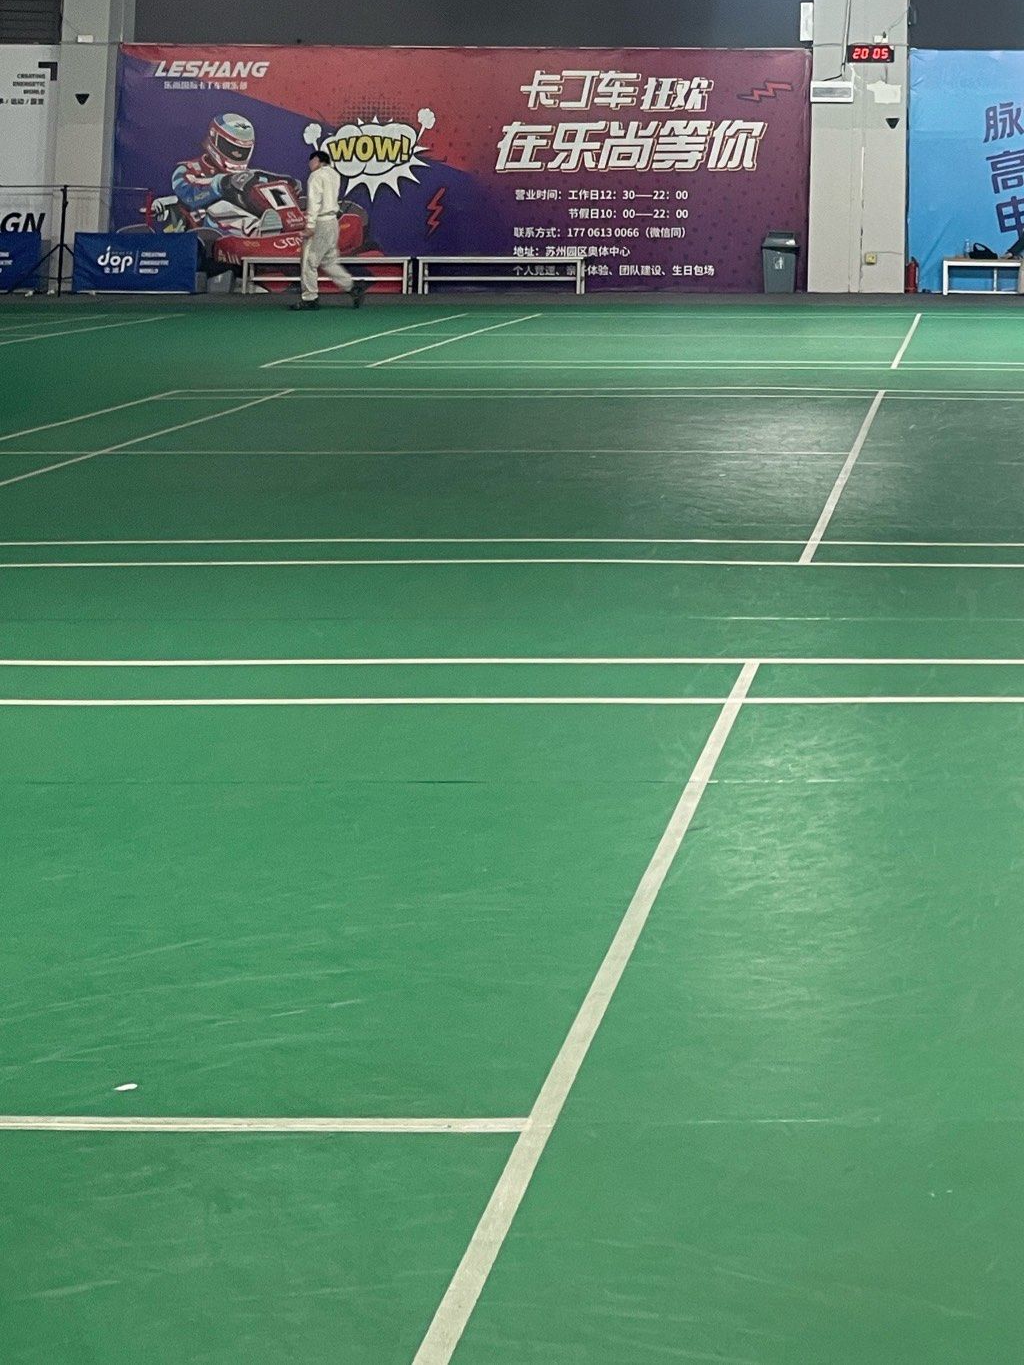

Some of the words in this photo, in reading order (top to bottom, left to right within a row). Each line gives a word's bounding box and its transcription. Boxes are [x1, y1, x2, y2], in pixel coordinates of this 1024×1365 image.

[154, 60, 271, 78] LESHANG
[327, 134, 412, 163] WOW!
[495, 119, 768, 173] 在乐尚等你
